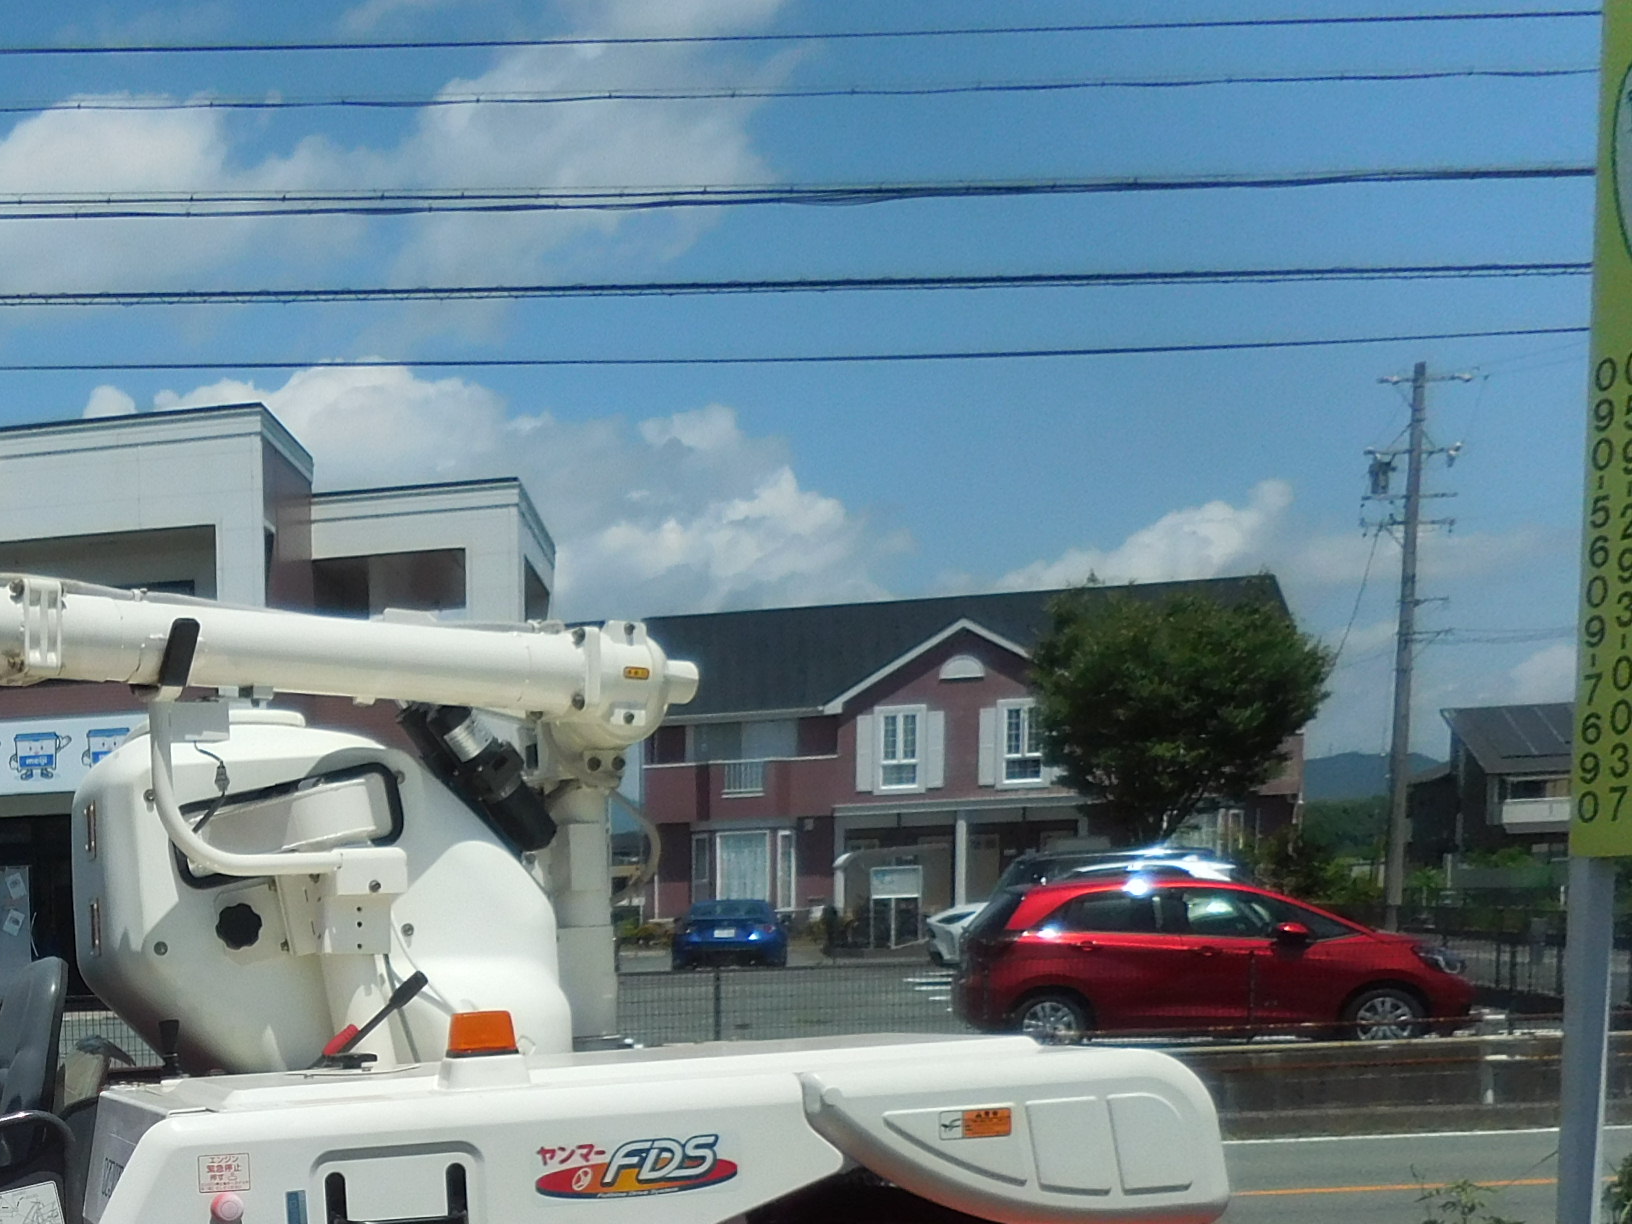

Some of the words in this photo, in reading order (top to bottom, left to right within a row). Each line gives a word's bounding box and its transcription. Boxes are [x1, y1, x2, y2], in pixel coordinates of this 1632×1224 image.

[1577, 357, 1617, 824] 090-5609-7690
[25, 756, 48, 767] meiji
[208, 1155, 239, 1164] エンジン
[537, 1143, 606, 1166] ヤンマー
[600, 1134, 719, 1187] FDS
[207, 1163, 242, 1173] 緊急停止
